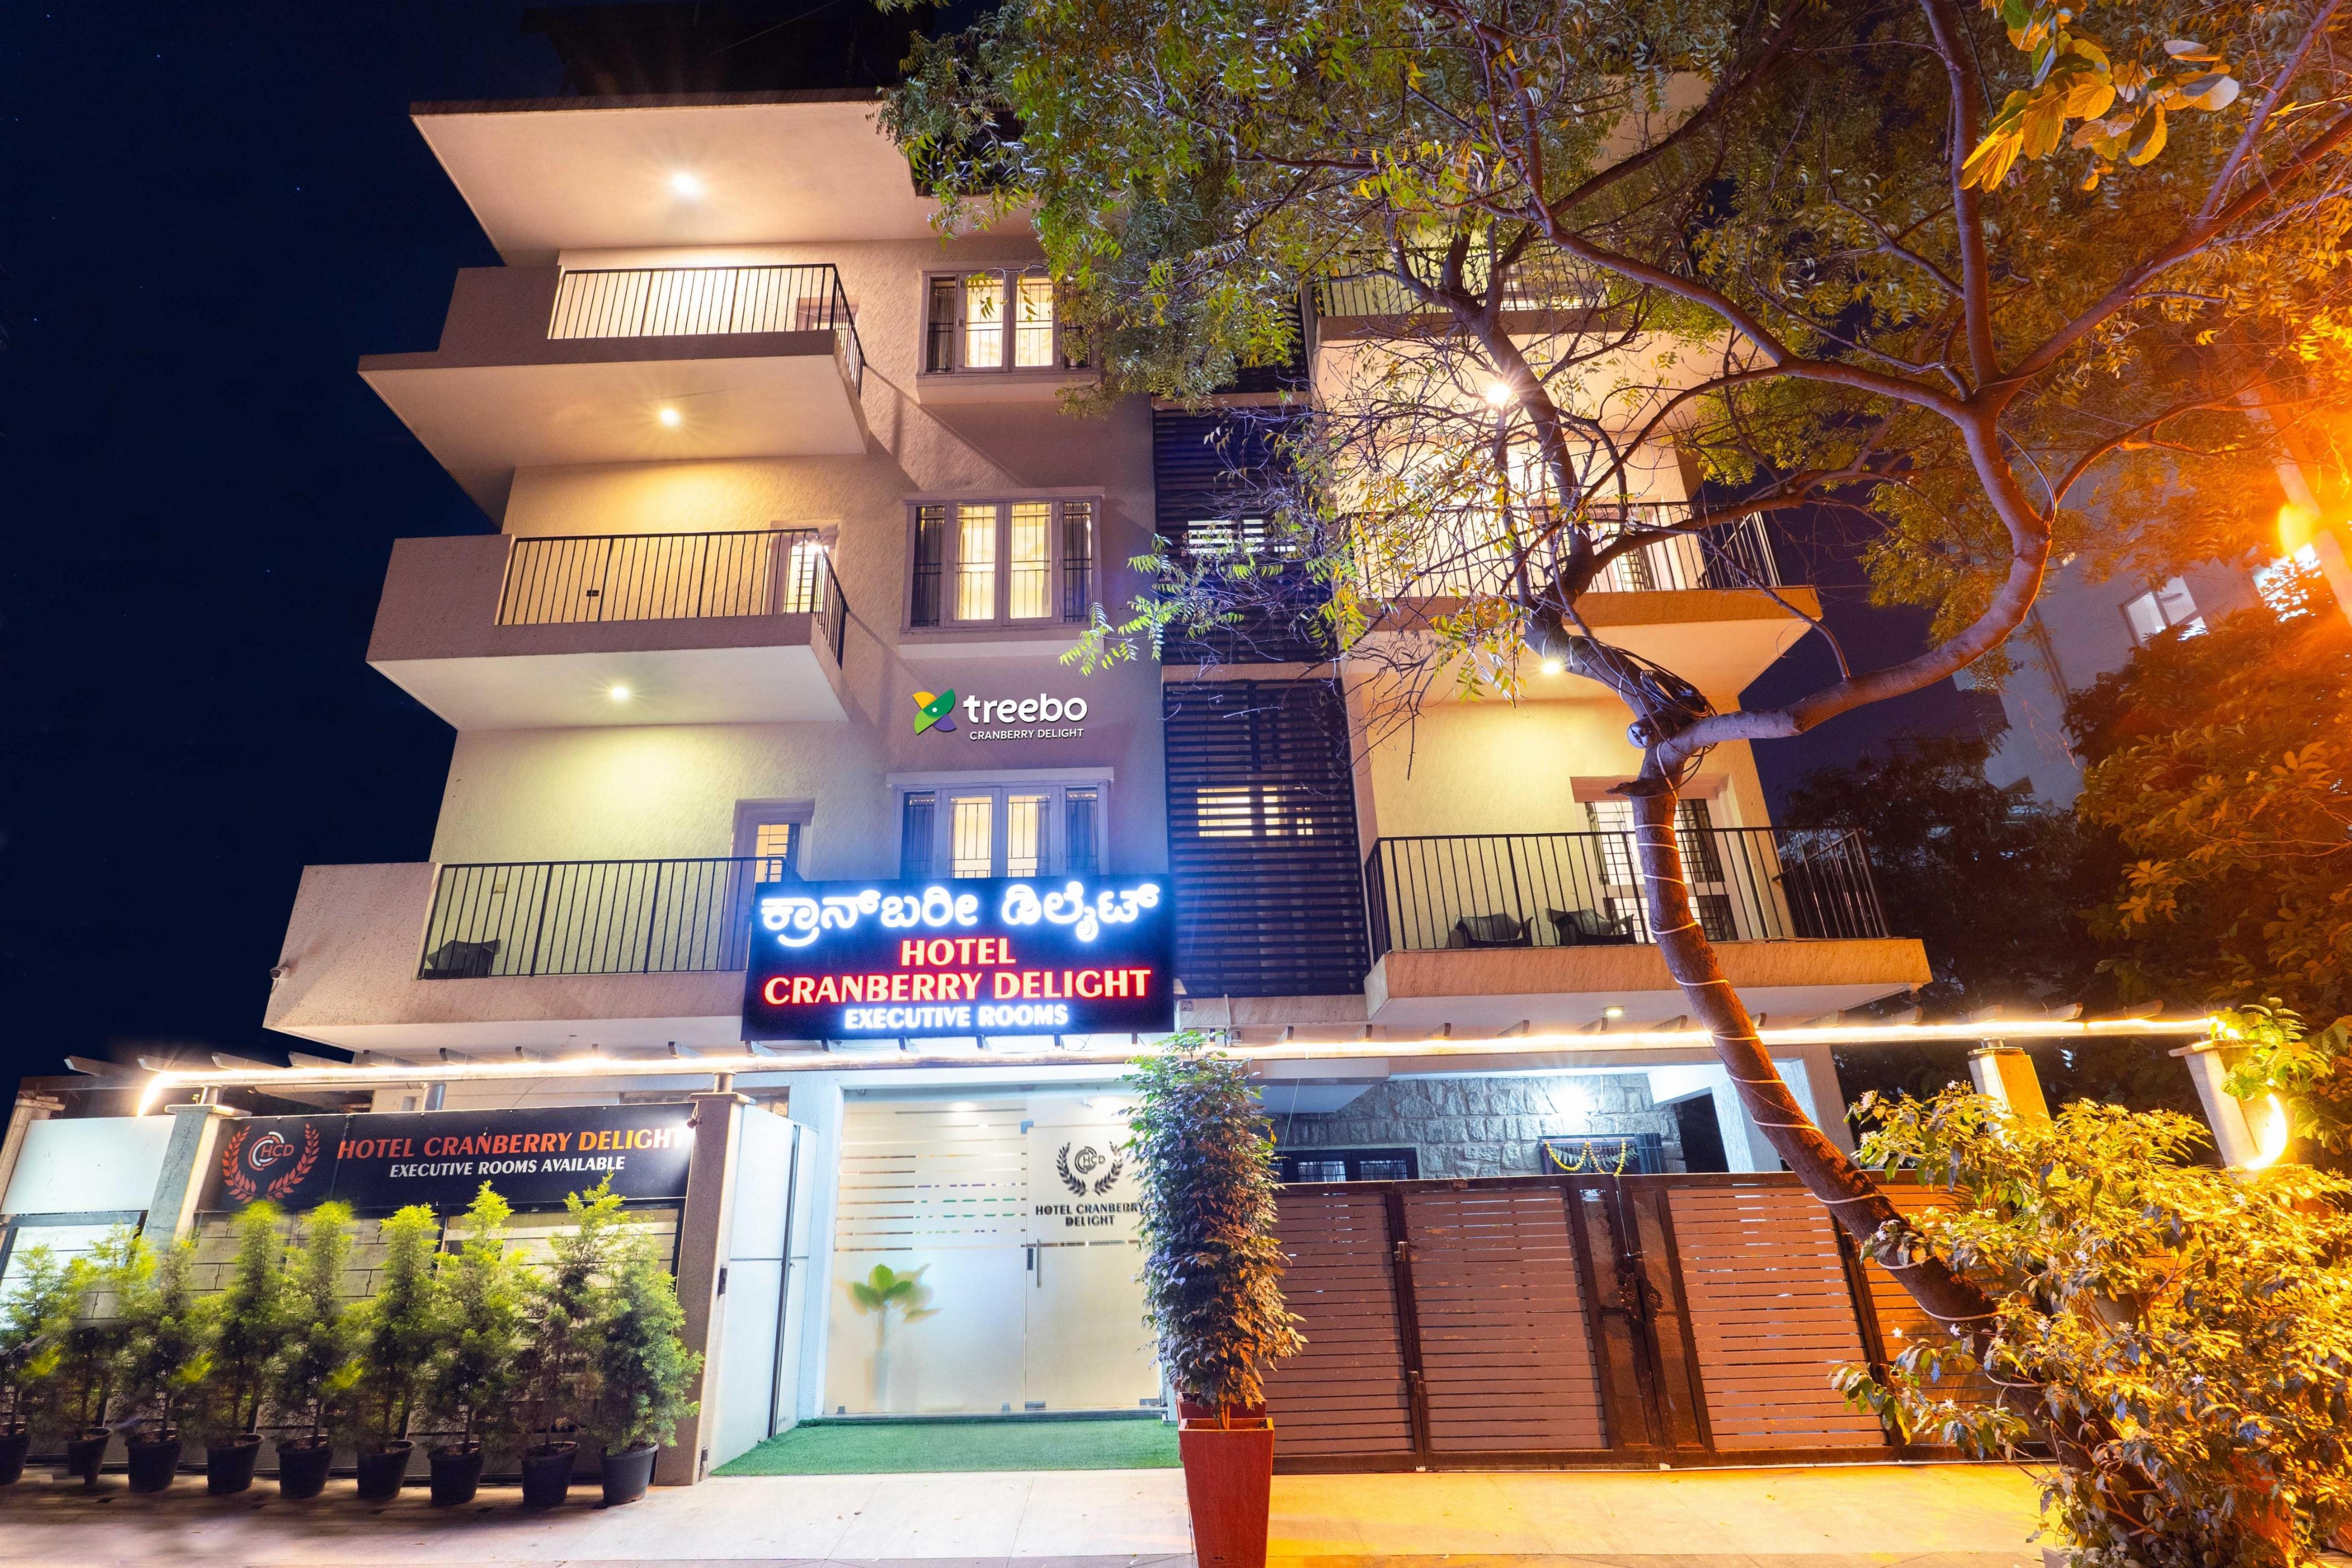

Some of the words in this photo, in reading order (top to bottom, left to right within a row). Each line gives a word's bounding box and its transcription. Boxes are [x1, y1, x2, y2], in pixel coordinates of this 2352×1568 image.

[963, 693, 1088, 723] treebo
[970, 730, 1035, 741] CRANBERRY
[1037, 728, 1084, 739] DELIGHT
[901, 938, 1016, 966] HOTEL
[764, 972, 983, 1005] CRANBERRY
[994, 970, 1151, 999] DELIGHT
[845, 1006, 971, 1029] EXECUTIVE
[978, 1005, 1069, 1027] ROOMS
[261, 1144, 295, 1157] HCD
[337, 1138, 414, 1159] HOTEL
[424, 1132, 573, 1157] CRANBERRY
[389, 1162, 473, 1178] EXECUTIVE
[478, 1159, 537, 1174] ROOMS
[540, 1156, 626, 1172] AVAILABLE
[1035, 1204, 1073, 1216] HOTEL
[1065, 1214, 1115, 1227] DELIGHT
